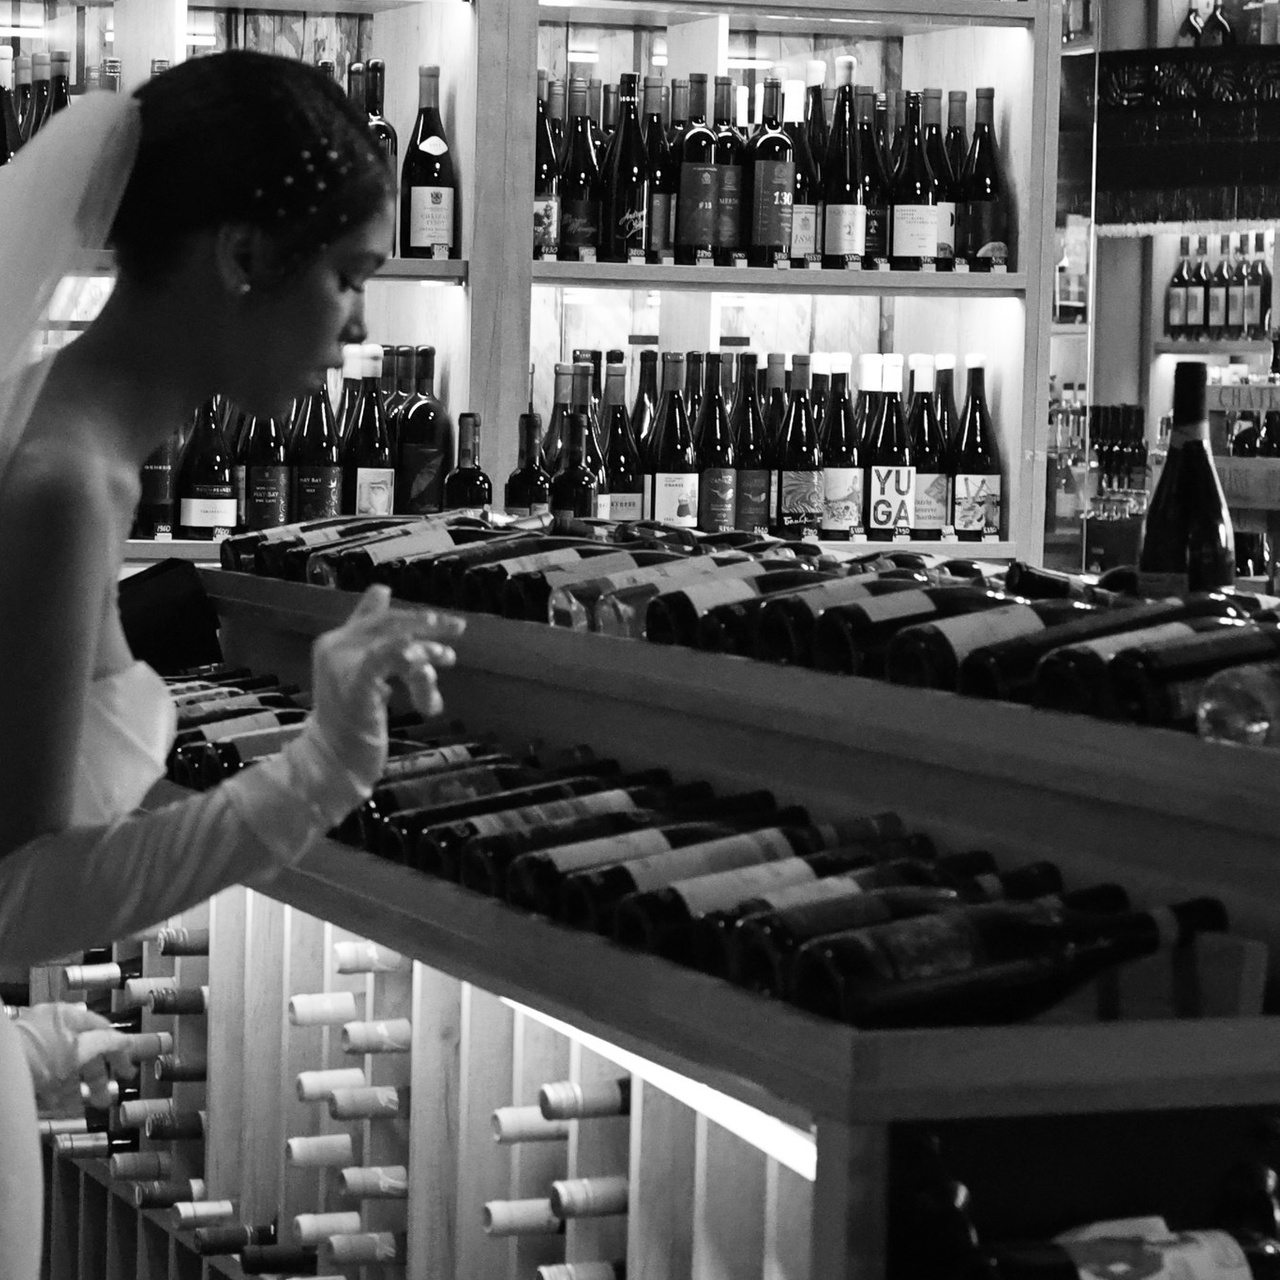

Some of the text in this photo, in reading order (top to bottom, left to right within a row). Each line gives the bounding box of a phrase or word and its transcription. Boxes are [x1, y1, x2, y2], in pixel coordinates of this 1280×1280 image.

[773, 191, 793, 206] 130
[874, 469, 911, 496] YU
[873, 499, 910, 526] GA
